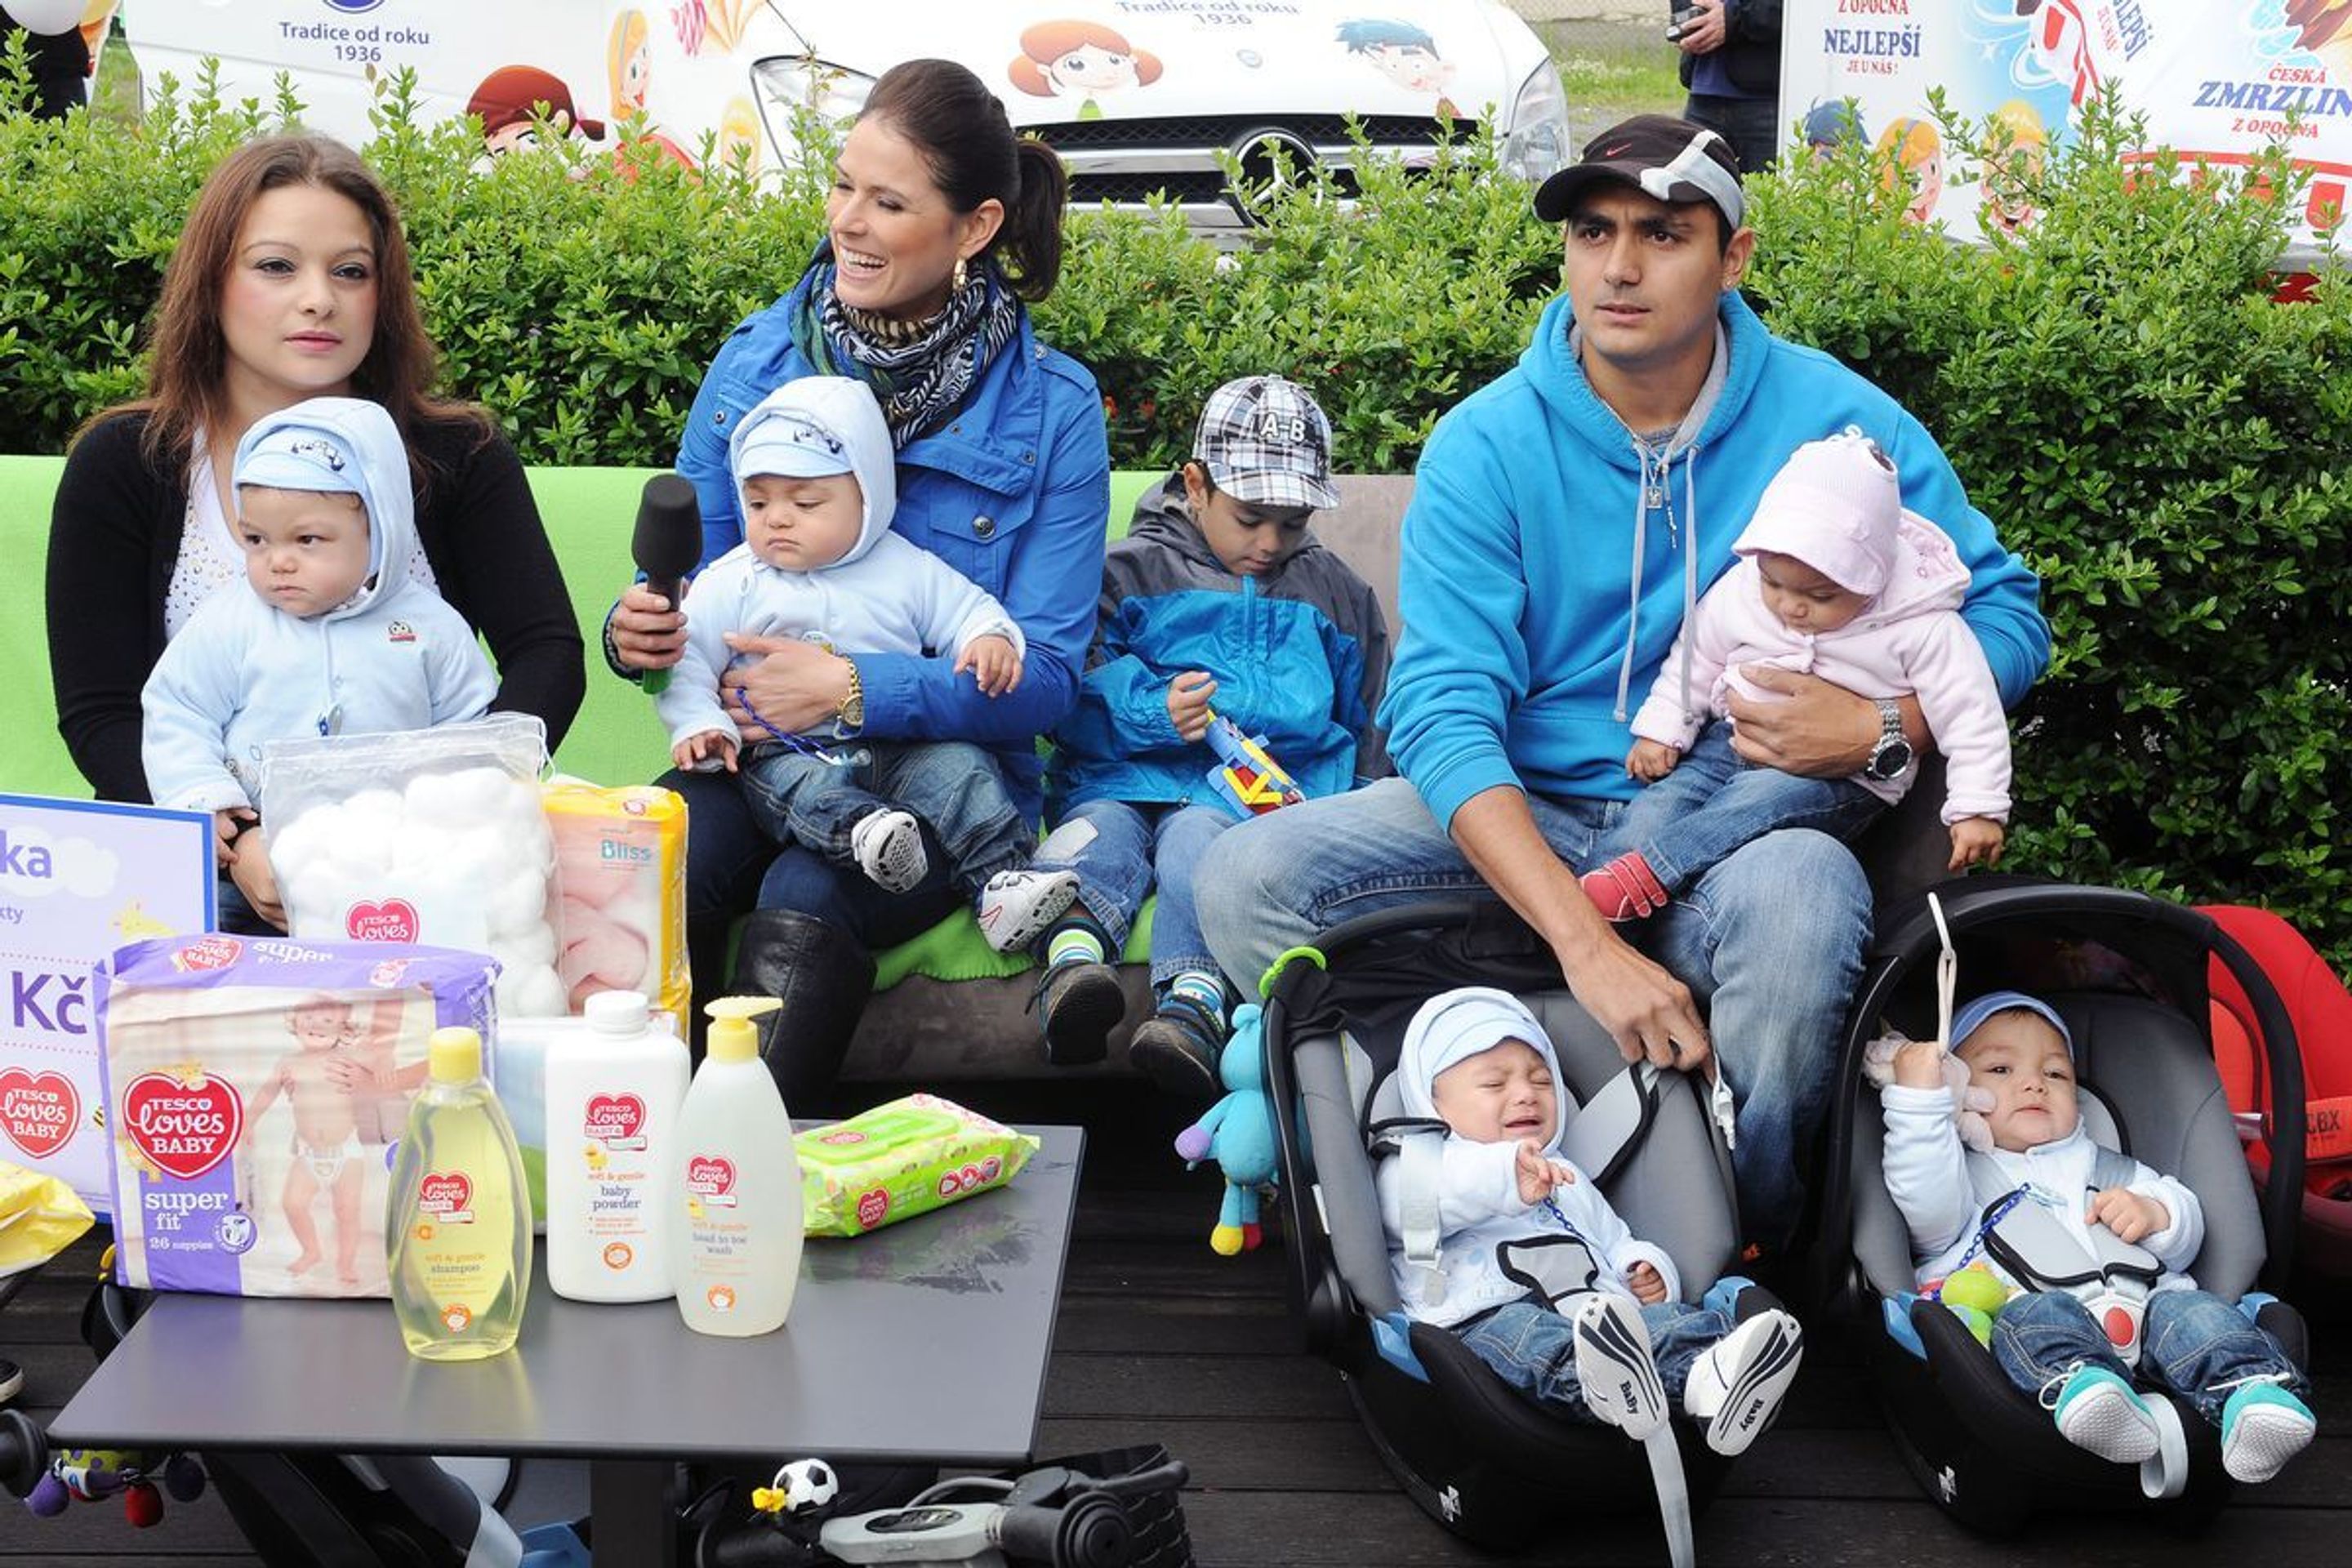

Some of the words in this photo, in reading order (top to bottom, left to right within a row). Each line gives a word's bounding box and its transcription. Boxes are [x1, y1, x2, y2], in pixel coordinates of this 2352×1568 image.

[1116, 2, 1204, 12] Tradice
[1209, 1, 1241, 12] od
[1245, 2, 1300, 16] roku
[1194, 13, 1253, 25] 1936
[279, 22, 350, 41] Tradice
[354, 26, 380, 42] od
[385, 27, 430, 44] roku
[1824, 24, 1922, 57] NEJLEPŠÍ
[334, 45, 381, 62] 1936
[2269, 63, 2328, 83] ČESKÁ
[2231, 118, 2245, 132] Z
[1259, 412, 1306, 443] A-B
[601, 839, 652, 862] Bliss
[356, 921, 409, 942] loves
[253, 941, 334, 963] super
[11, 970, 87, 1035] Kč
[11, 1088, 59, 1103] TESCO
[148, 1098, 212, 1111] TESCO
[4, 1091, 66, 1125] loves
[594, 1108, 637, 1125] loves
[140, 1103, 225, 1135] loves
[12, 1121, 60, 1139] BABY
[151, 1137, 216, 1153] BABY
[601, 1184, 631, 1200] baby
[145, 1192, 229, 1216] super
[593, 1196, 641, 1212] powder
[156, 1212, 181, 1231] fit
[149, 1236, 170, 1250] 26
[430, 1263, 482, 1276] shampoo
